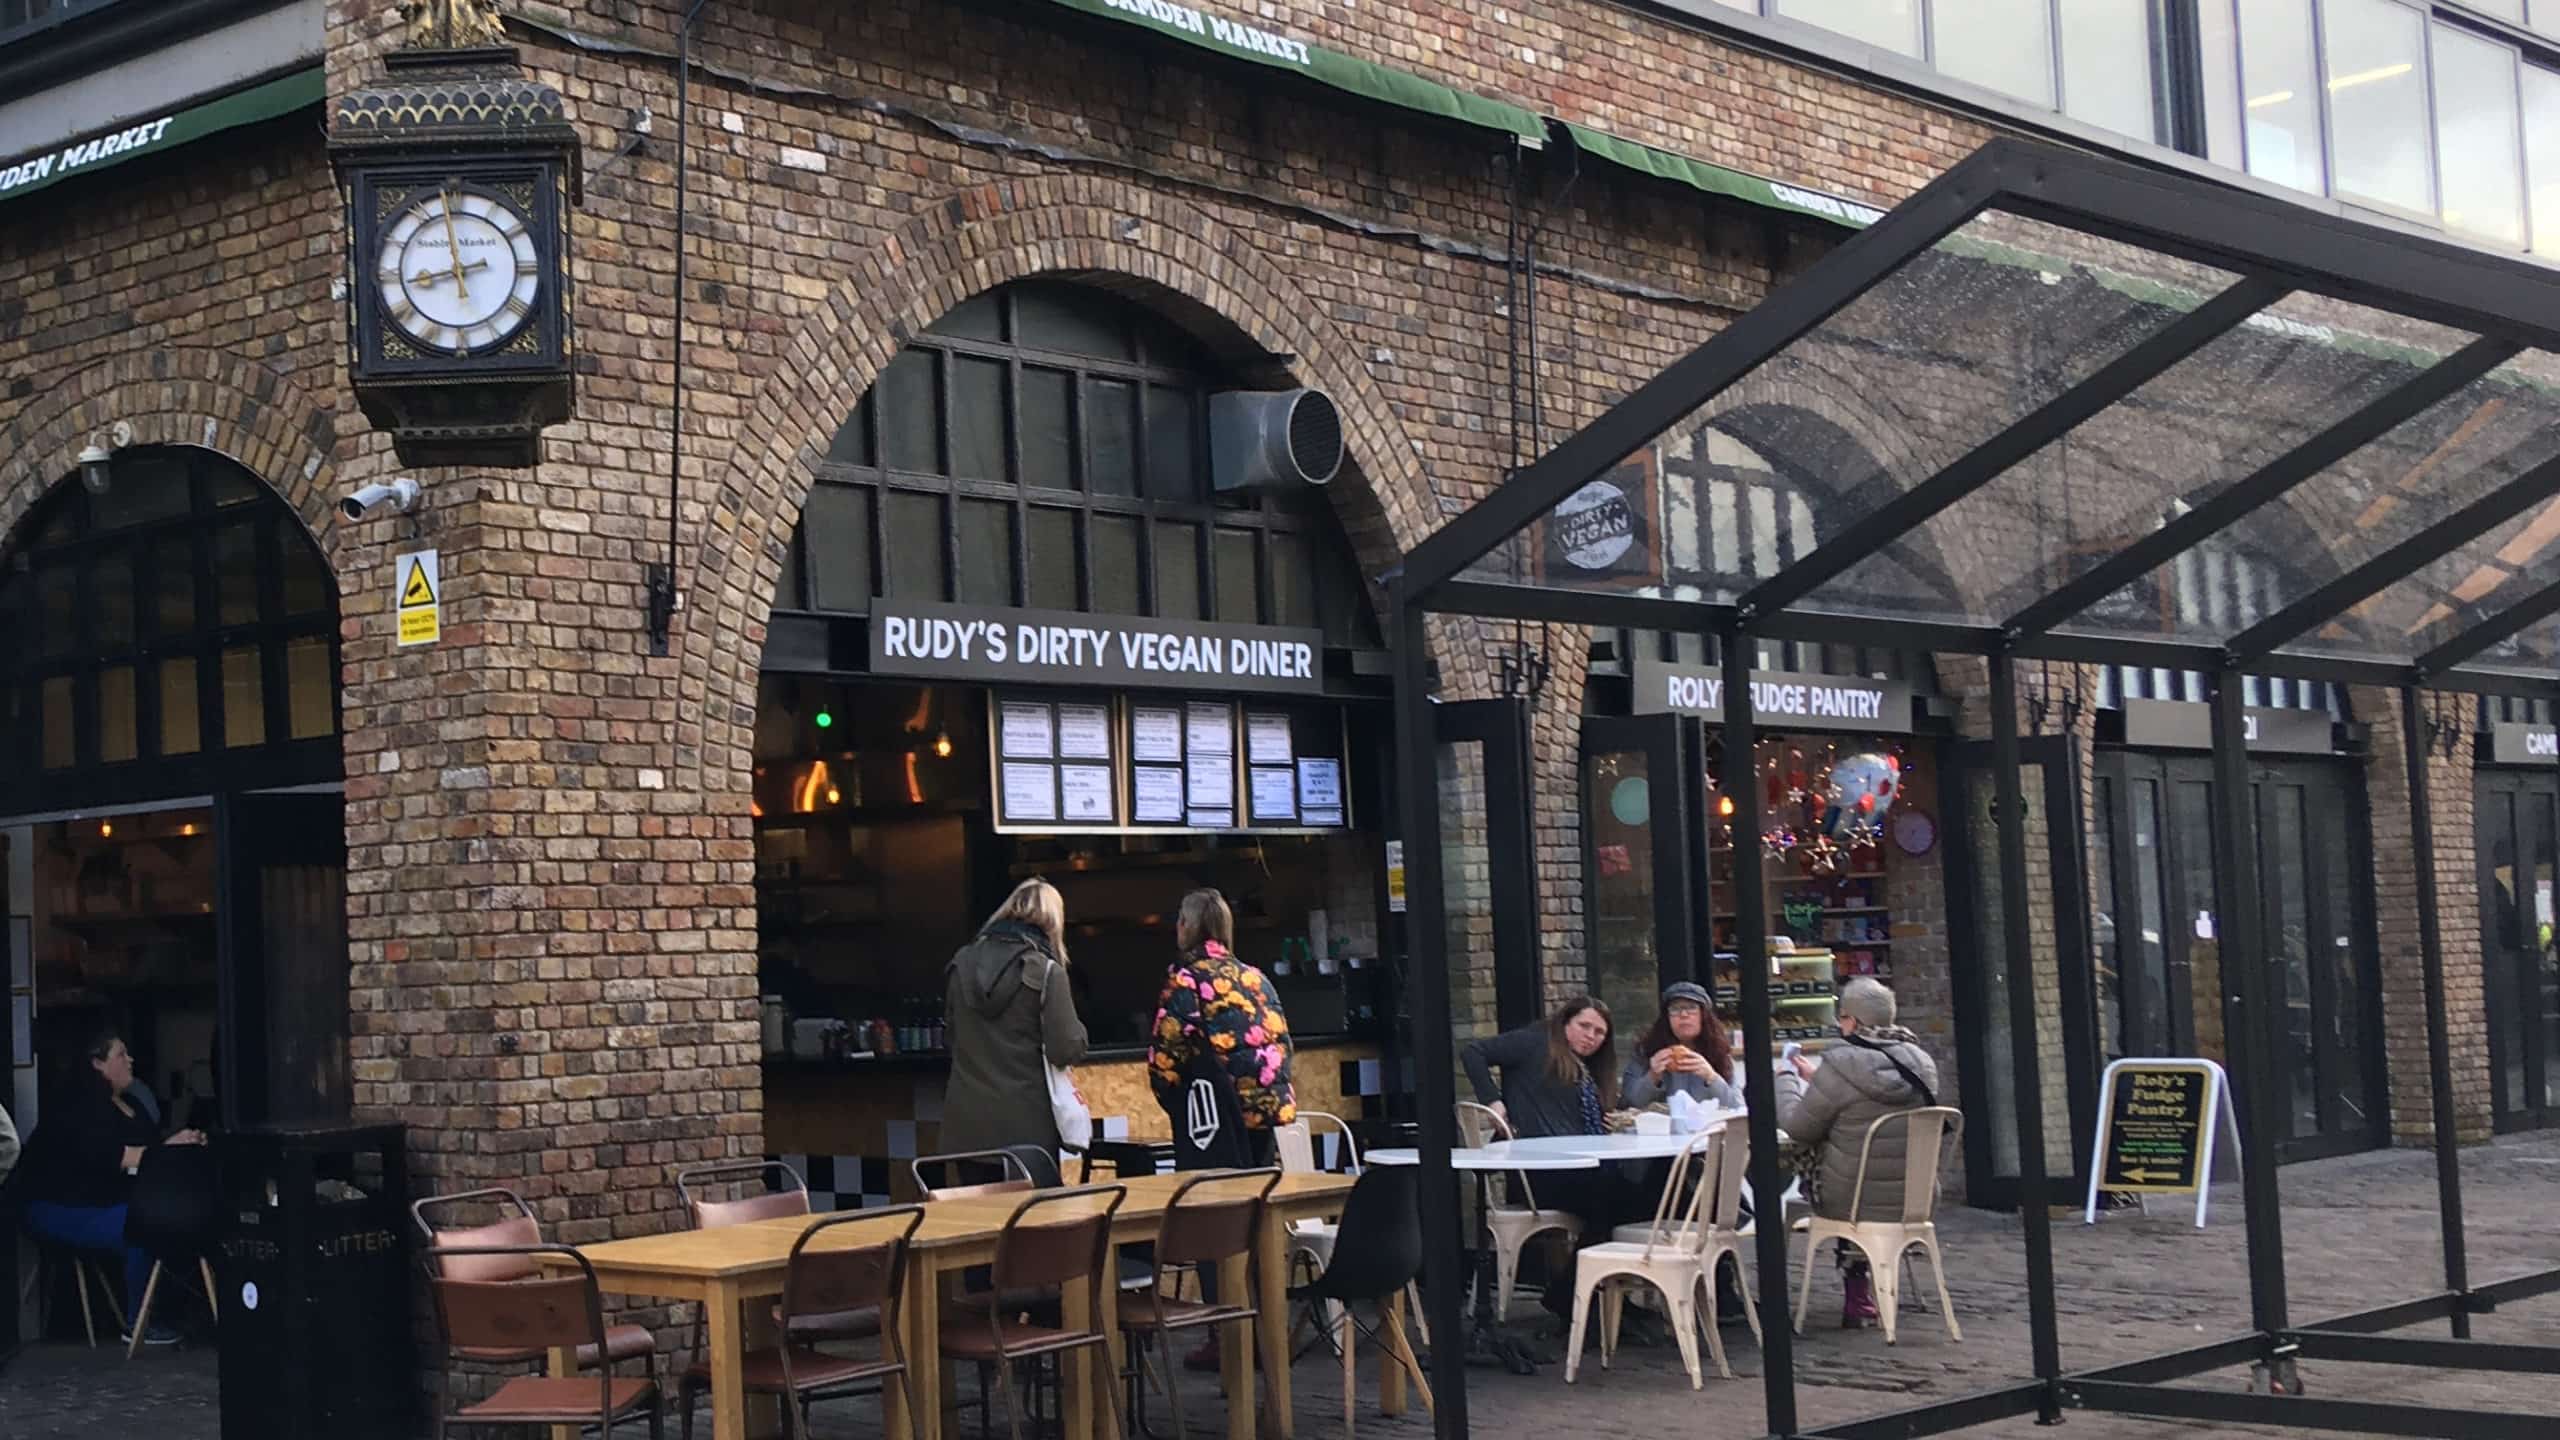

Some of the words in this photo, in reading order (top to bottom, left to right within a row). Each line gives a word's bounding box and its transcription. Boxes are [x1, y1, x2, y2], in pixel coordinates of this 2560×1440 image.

[1208, 15, 1311, 65] MARKET
[57, 116, 174, 172] MARKET
[1561, 513, 1628, 548] VEGAN
[883, 616, 1008, 664] RUDY'S
[1016, 624, 1111, 667] DIRTY
[1118, 631, 1223, 674] VEGAN
[1229, 639, 1313, 679] DINER
[1810, 687, 1883, 720] PANTRY
[2132, 1088, 2185, 1104] Fudge
[2133, 1073, 2187, 1088] Roly's
[2126, 1103, 2187, 1118] Pantry
[323, 1229, 392, 1257] LITTER
